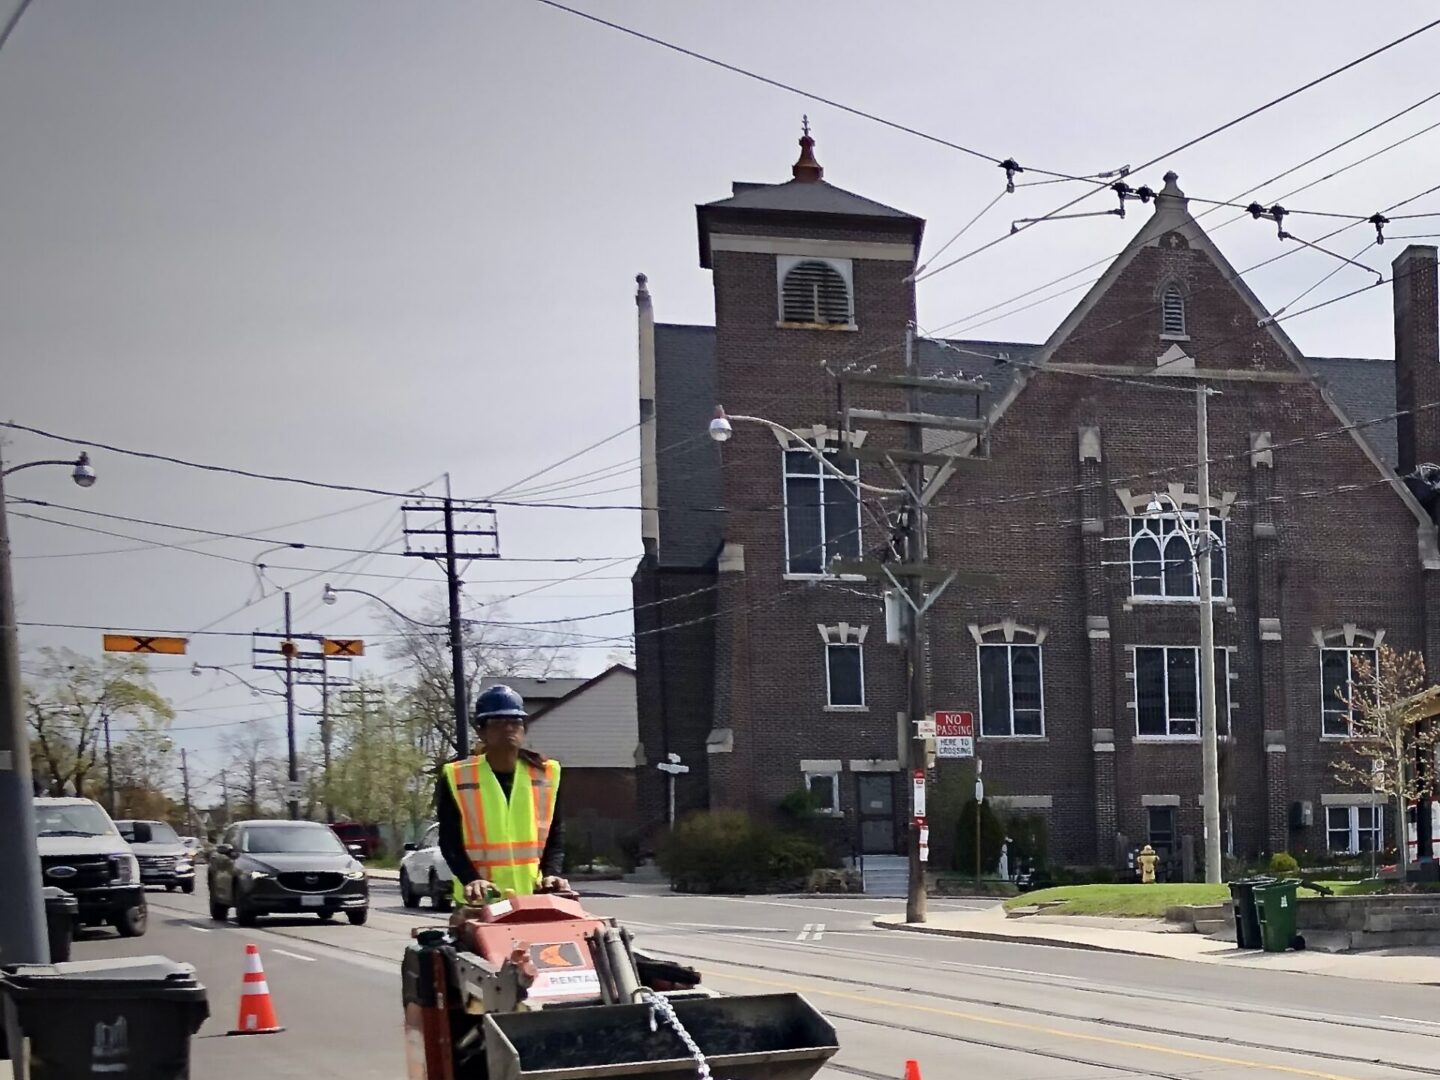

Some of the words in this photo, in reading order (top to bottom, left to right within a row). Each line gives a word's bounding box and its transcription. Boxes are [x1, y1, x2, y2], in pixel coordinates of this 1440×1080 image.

[945, 714, 962, 725] NO
[936, 724, 972, 736] PASSING
[940, 738, 957, 746] HERE
[960, 738, 970, 746] TO
[939, 747, 972, 755] CROSSING
